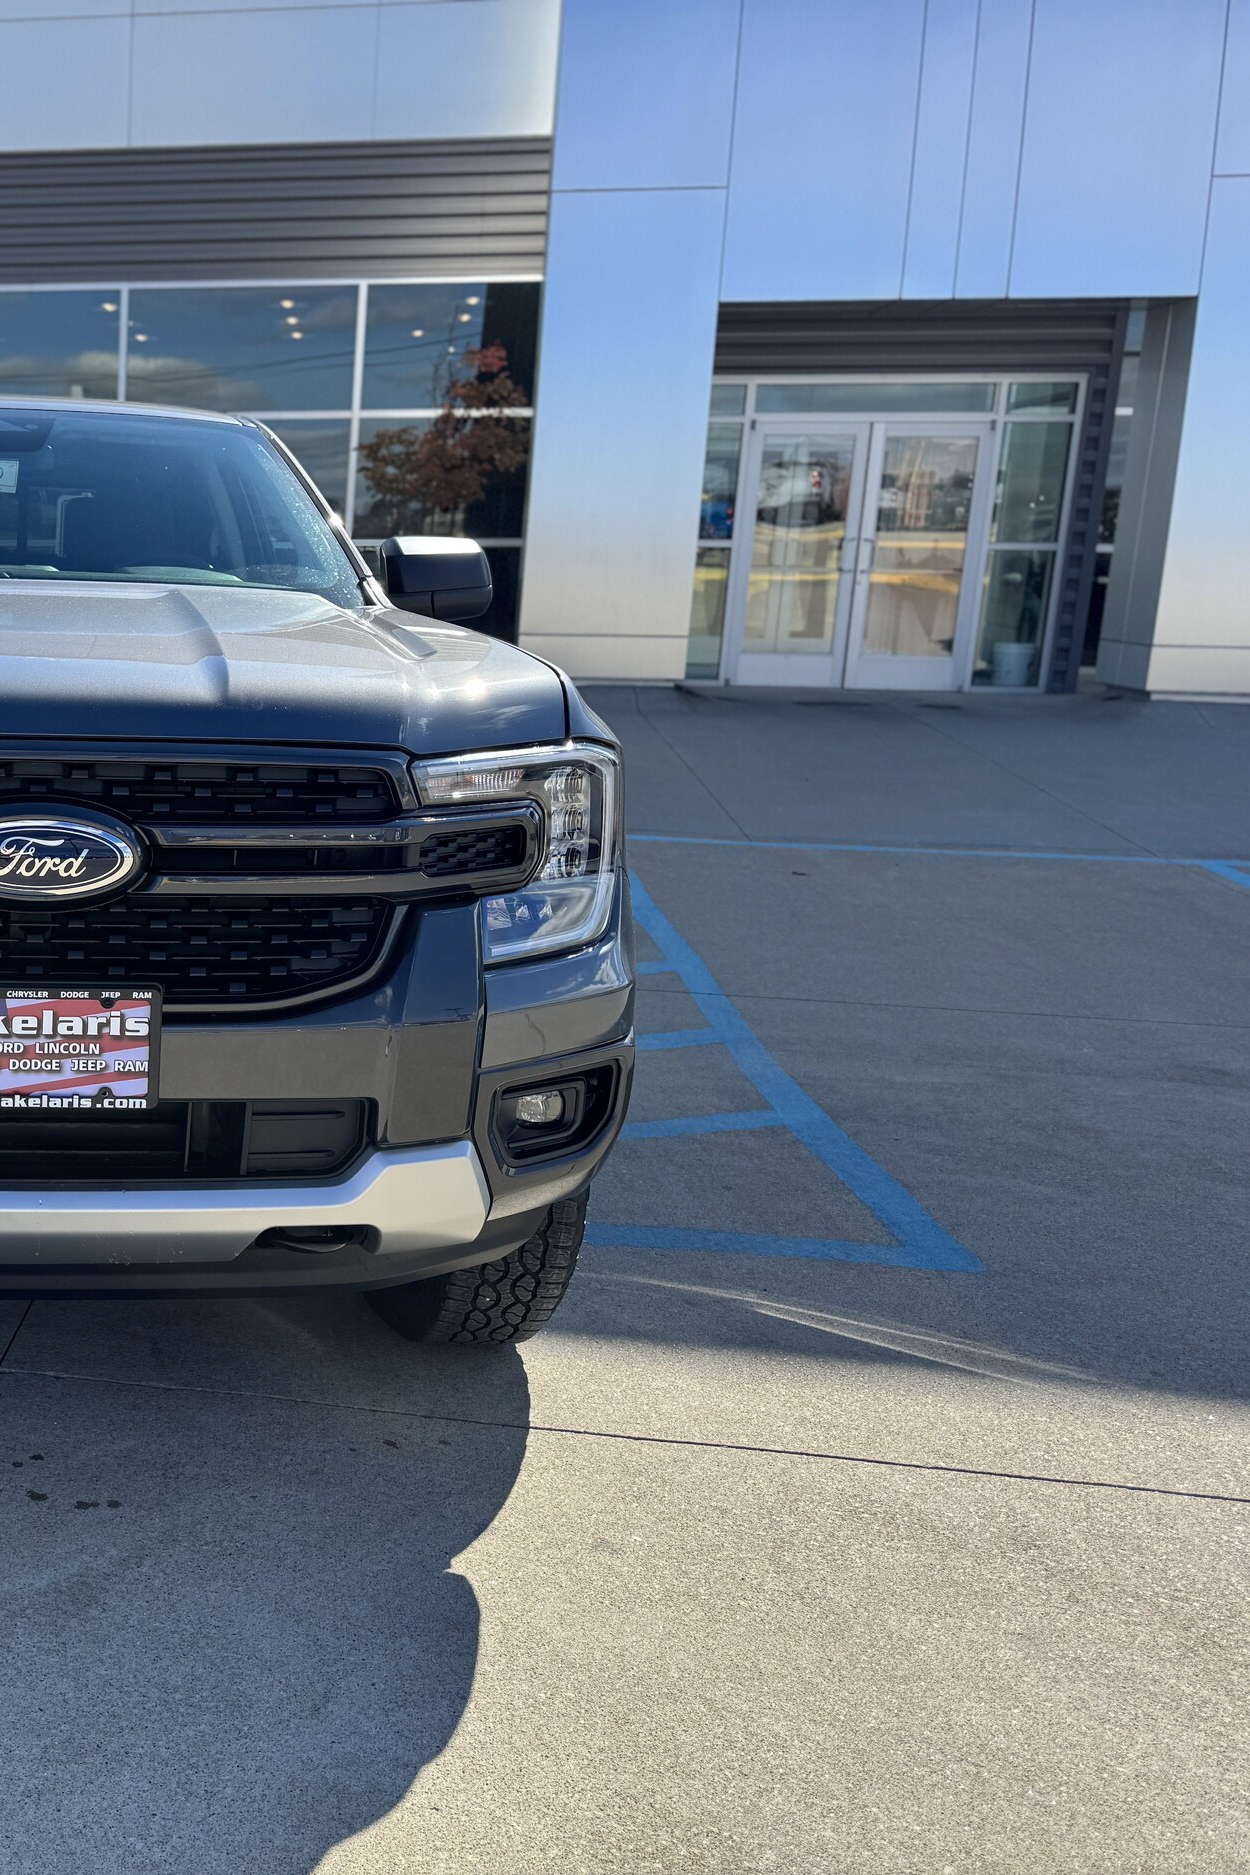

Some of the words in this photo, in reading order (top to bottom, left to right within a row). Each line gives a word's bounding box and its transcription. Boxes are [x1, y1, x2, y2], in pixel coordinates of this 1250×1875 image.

[6, 990, 49, 999] CHRYSLER
[60, 991, 90, 999] DODGE
[100, 991, 121, 999] JEEP
[132, 991, 152, 999] RAM
[35, 1042, 100, 1055] LINCOLN
[9, 1059, 61, 1071] DODGE
[70, 1059, 107, 1072] JEEP
[114, 1060, 149, 1072] RAM
